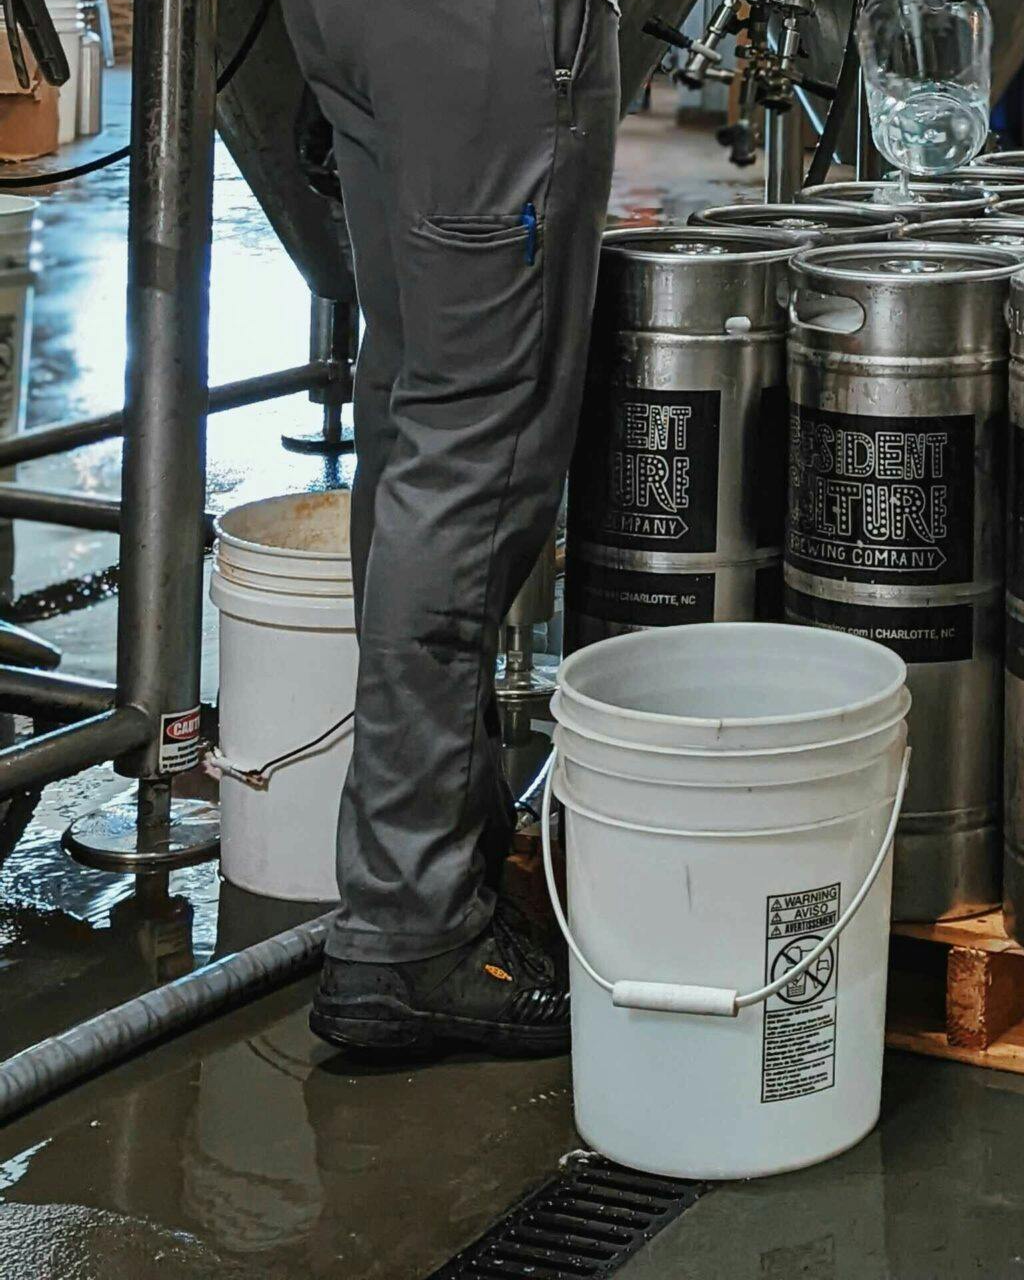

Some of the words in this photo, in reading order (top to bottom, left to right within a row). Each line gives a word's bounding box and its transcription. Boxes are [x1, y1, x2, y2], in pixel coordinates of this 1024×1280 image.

[851, 548, 937, 569] COMPANY
[680, 594, 696, 606] NC
[940, 627, 956, 638] NC
[783, 887, 838, 908] WARNING
[794, 903, 829, 920] AVISO
